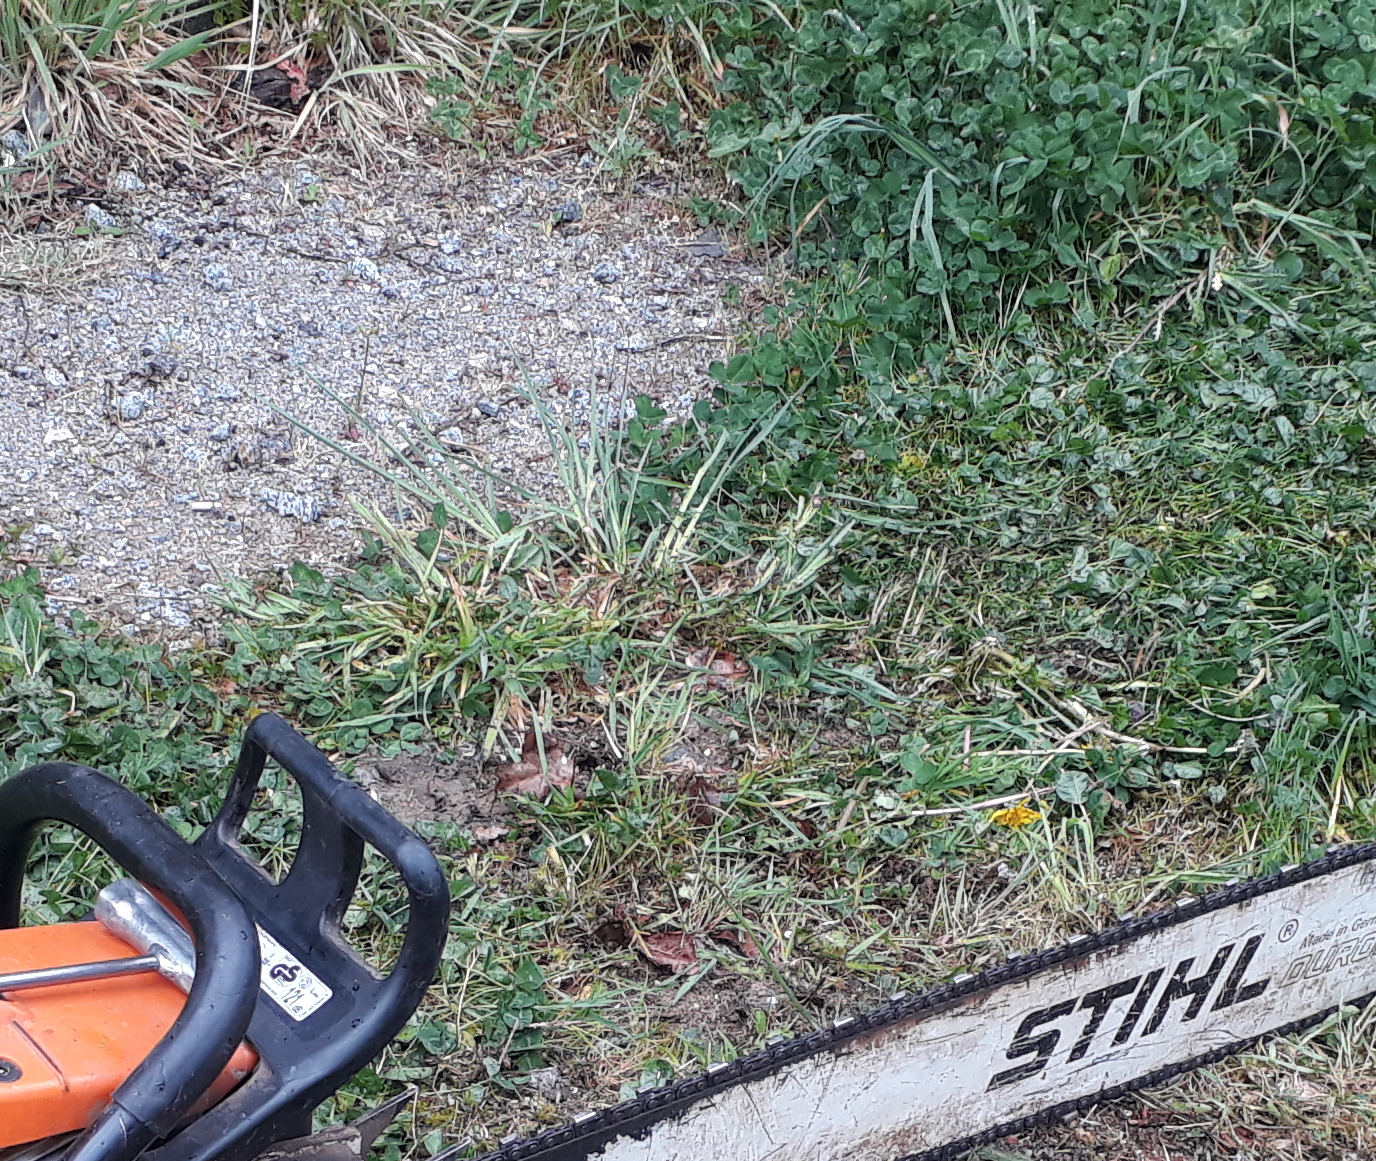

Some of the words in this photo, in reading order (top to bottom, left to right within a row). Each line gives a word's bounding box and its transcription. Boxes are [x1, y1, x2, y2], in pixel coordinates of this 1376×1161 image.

[1298, 931, 1335, 950] Made
[1336, 923, 1349, 938] in
[985, 933, 1271, 1093] STIHL
